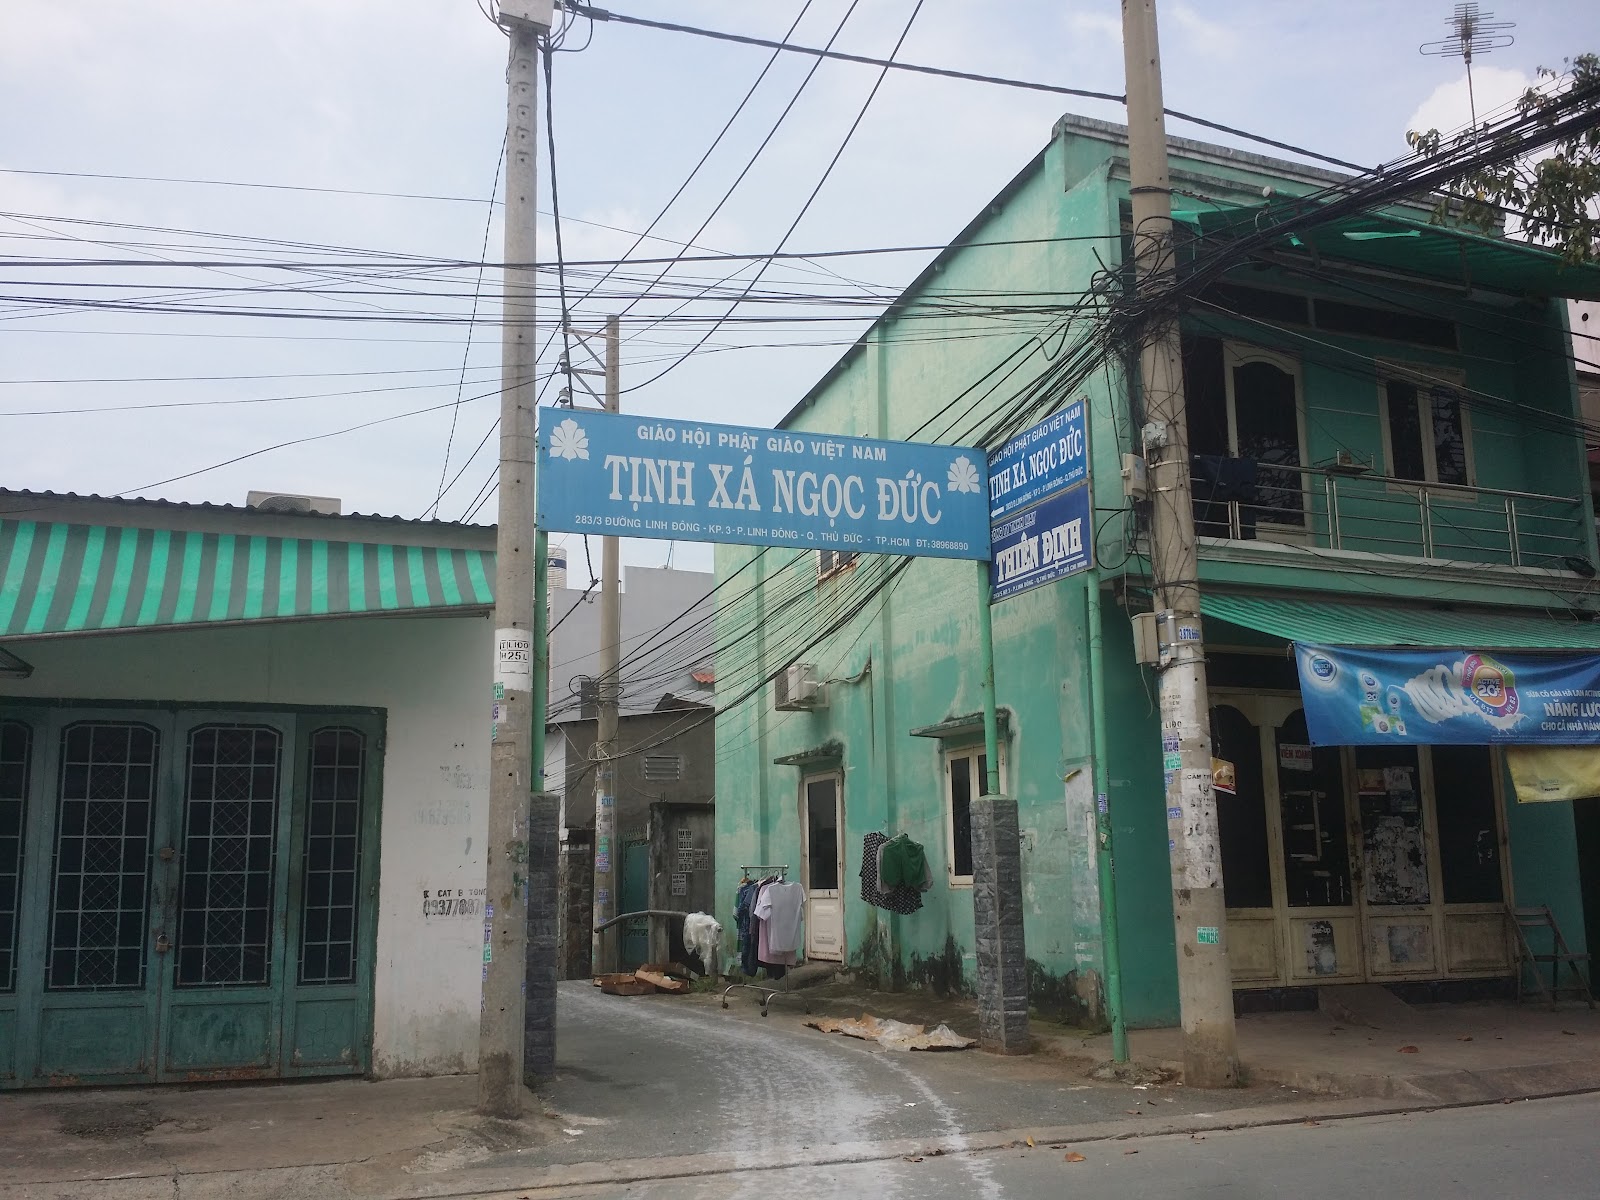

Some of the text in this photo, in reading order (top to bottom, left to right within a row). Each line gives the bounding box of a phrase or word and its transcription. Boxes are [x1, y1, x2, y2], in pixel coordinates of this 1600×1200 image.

[638, 424, 886, 462] GIÁO HỘI PHẬT GIÁO VIỆT NAM
[1003, 442, 1014, 458] HỘI
[1014, 434, 1031, 450] PHẬT
[1032, 424, 1048, 442] GIÁO
[1049, 415, 1064, 431] VIỆT
[1065, 405, 1080, 424] NAM
[989, 425, 1082, 504] TỊNH XÁ NGỌC ĐỨC
[604, 454, 942, 528] TỊNH XÁ NGỌC ĐỨC
[575, 515, 602, 525] 283/3
[605, 516, 640, 528] ĐƯỜNG
[646, 520, 668, 530] LINH
[672, 520, 700, 532] ĐÔNG
[747, 528, 768, 536] LINH
[772, 528, 798, 538] ĐÔNG
[820, 531, 838, 541] THỦ
[843, 533, 862, 544] ĐỨC
[876, 536, 910, 547] TP.HCM
[1478, 684, 1501, 697] 20+
[1544, 699, 1578, 716] NĂNG
[1542, 722, 1556, 731] CHO
[1557, 720, 1567, 730] CẢ
[1567, 720, 1583, 731] NHÀ
